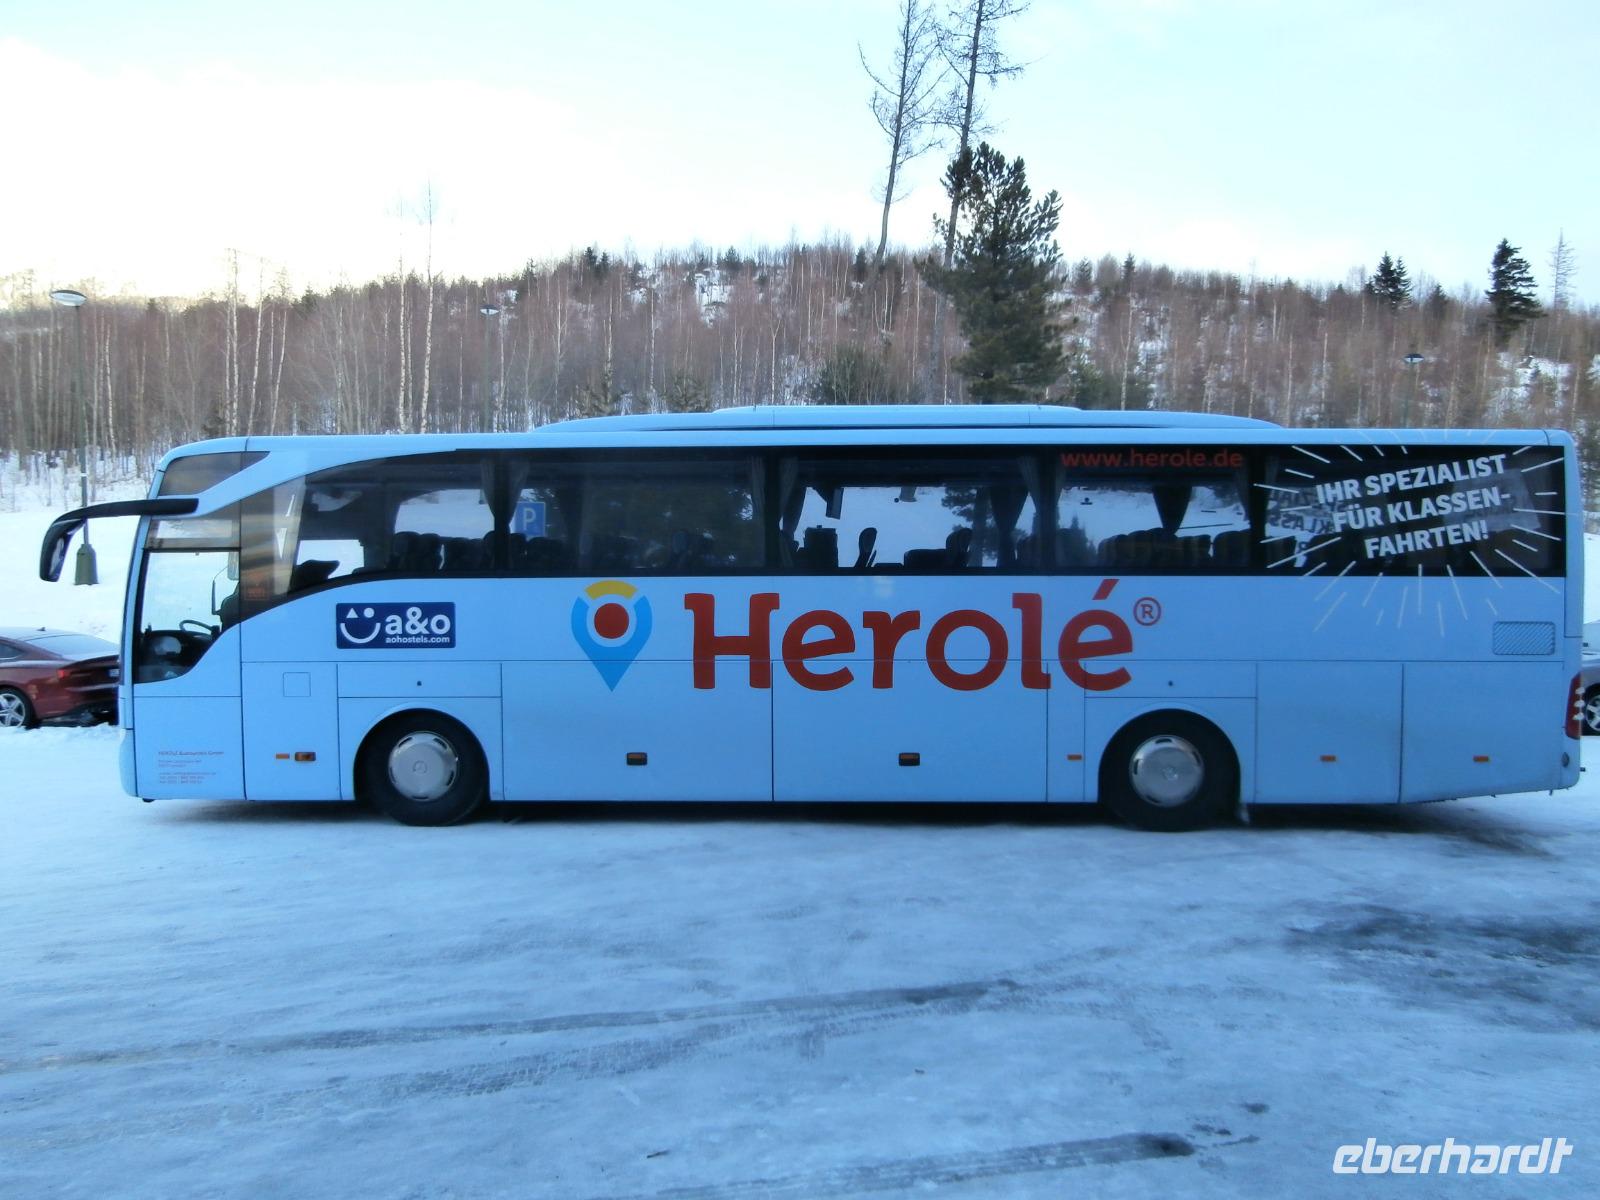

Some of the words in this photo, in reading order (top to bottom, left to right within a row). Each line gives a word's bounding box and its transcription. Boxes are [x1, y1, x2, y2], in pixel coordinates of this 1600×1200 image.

[1060, 448, 1244, 467] www.herole.de
[1316, 479, 1362, 504] IHR
[1366, 454, 1506, 496] SPEZIALIST
[1331, 504, 1384, 533] FÜR
[1387, 486, 1510, 522] KLASSEN-
[1364, 520, 1489, 559] FAHRTEN!
[385, 606, 451, 635] a&o
[385, 635, 450, 644] aohostels.com
